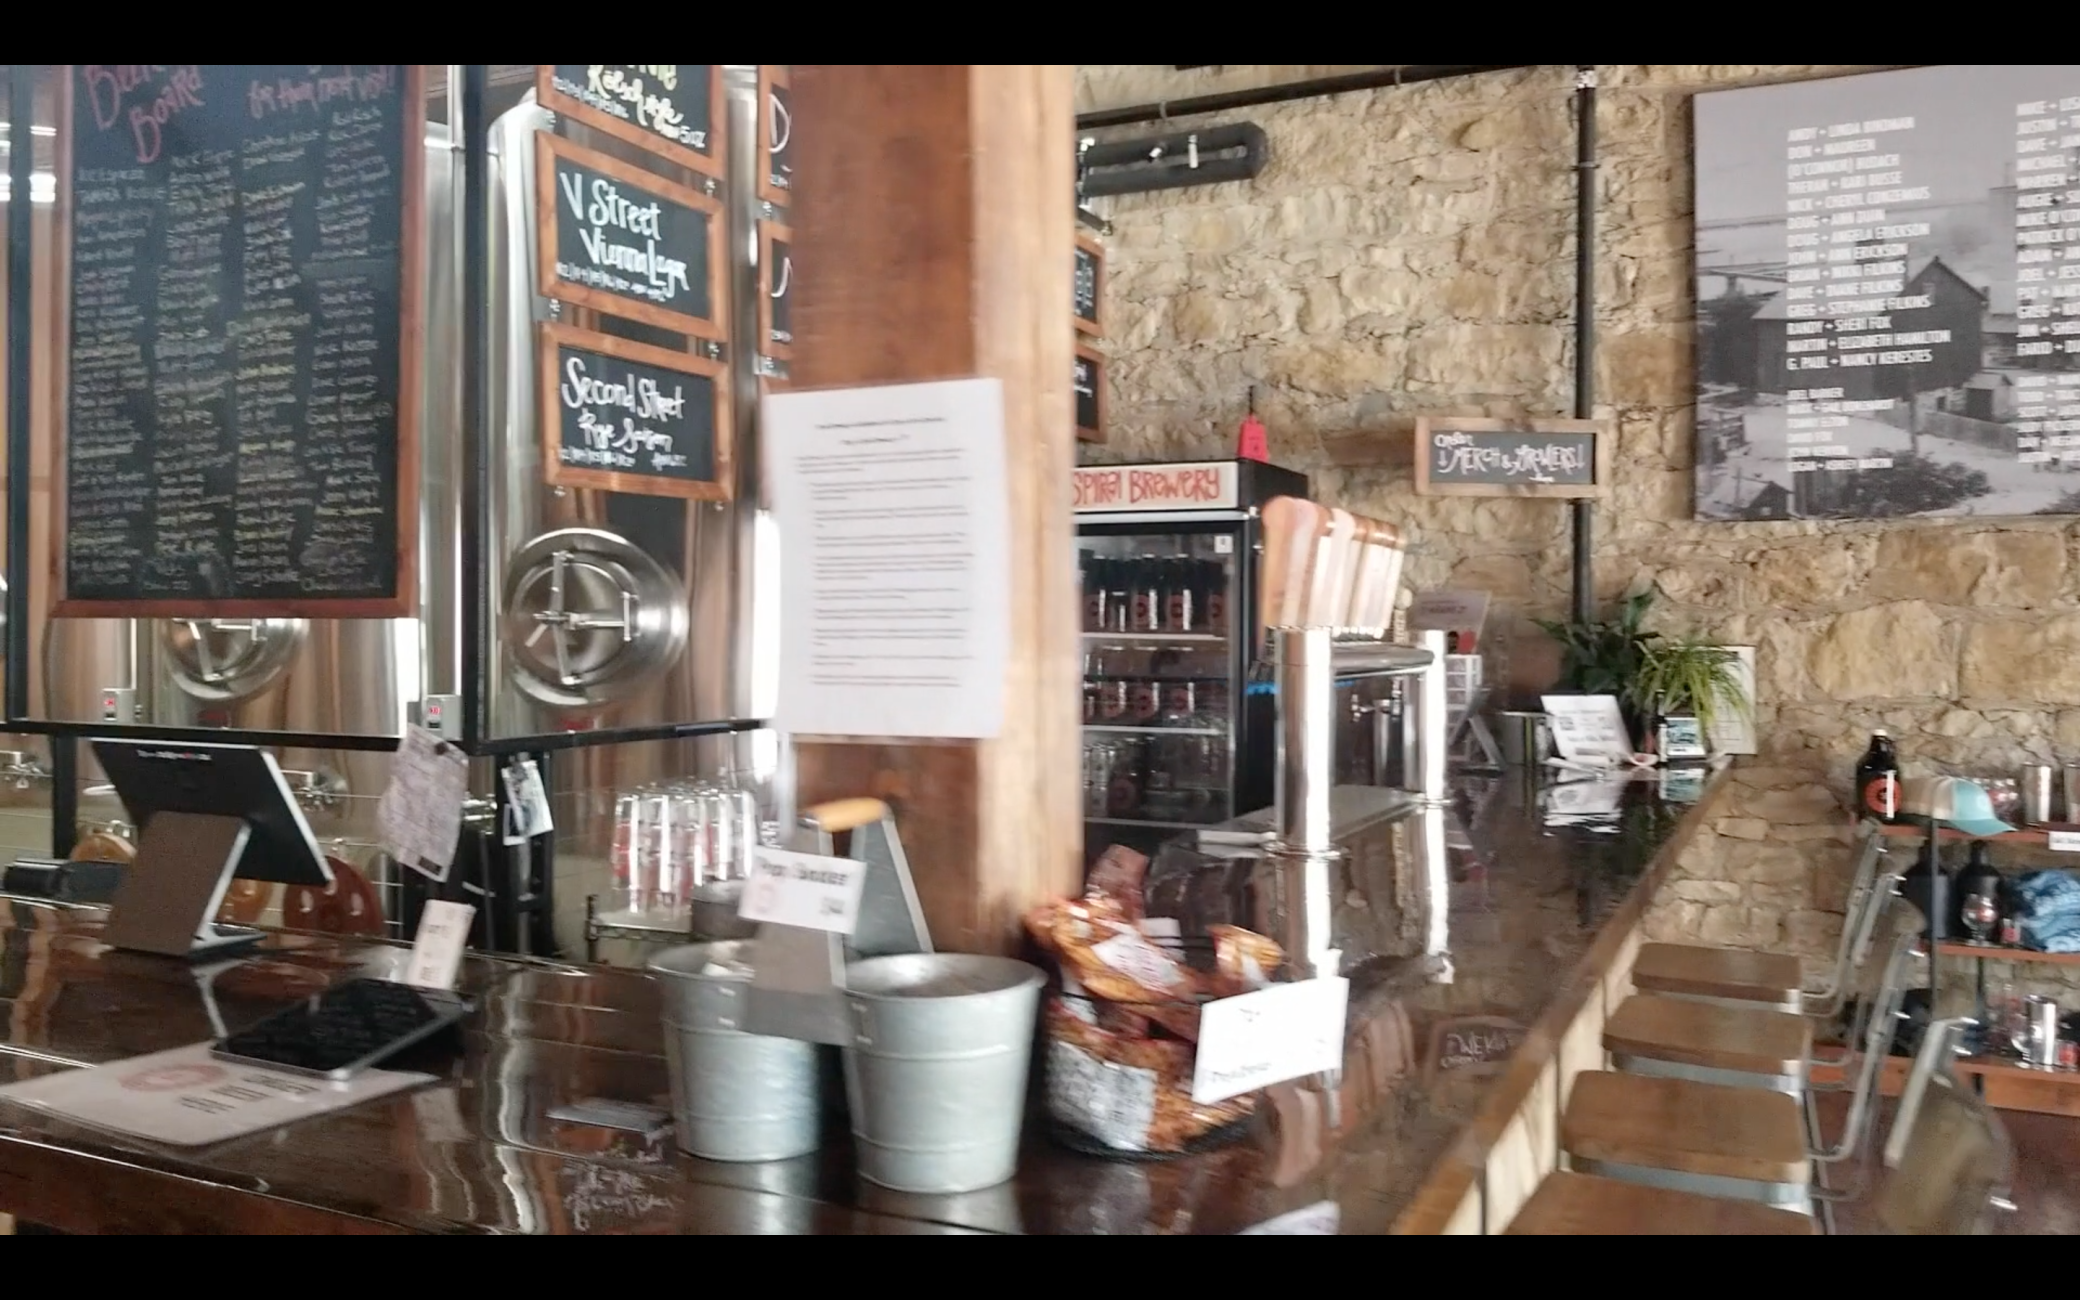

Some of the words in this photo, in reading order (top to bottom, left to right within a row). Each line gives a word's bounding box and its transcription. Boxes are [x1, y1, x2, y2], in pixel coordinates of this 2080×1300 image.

[559, 172, 584, 220] V
[588, 179, 662, 240] Street
[562, 357, 637, 413] Second
